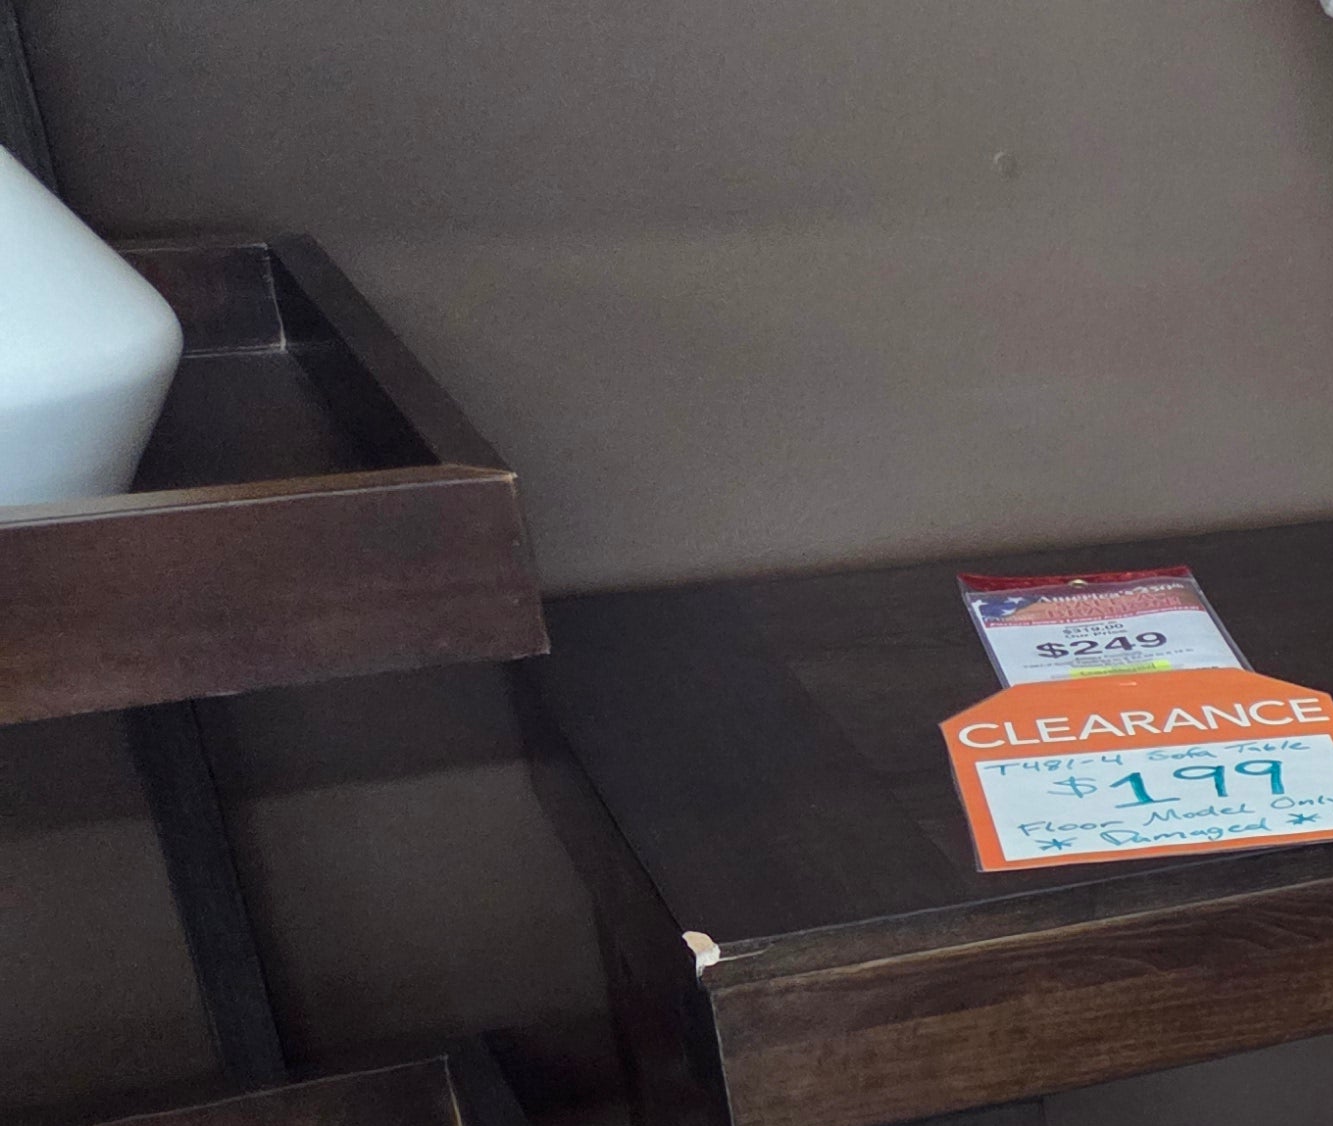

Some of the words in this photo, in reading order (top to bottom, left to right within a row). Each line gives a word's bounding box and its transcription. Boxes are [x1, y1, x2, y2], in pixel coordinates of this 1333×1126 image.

[1036, 631, 1168, 659] $249
[958, 697, 1331, 750] CLEARANCE
[983, 754, 1124, 776] T481-4
[1146, 742, 1216, 762] Sofa
[1223, 741, 1312, 754] Table
[1047, 759, 1285, 808] $199
[1017, 820, 1124, 838] Floor
[1143, 804, 1256, 827] Model
[1100, 817, 1271, 847] Damaged
